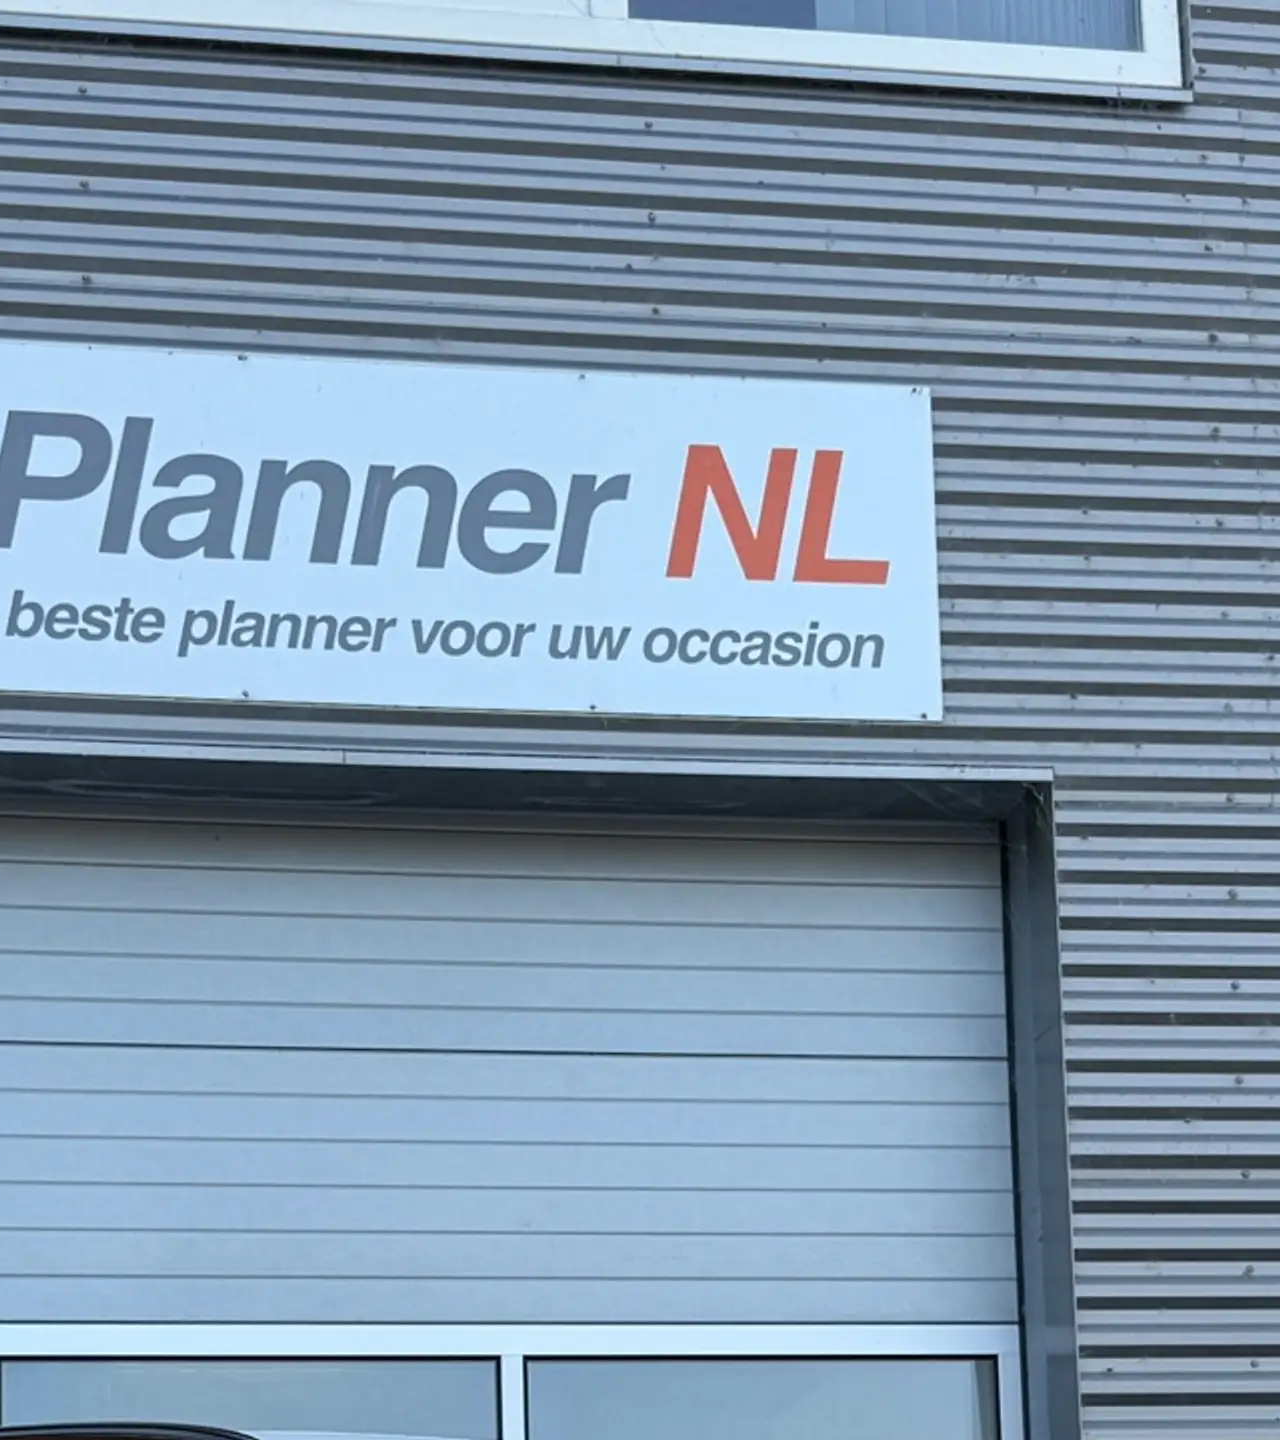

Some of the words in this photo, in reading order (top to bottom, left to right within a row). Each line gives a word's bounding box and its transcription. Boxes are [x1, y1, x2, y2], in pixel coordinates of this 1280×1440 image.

[665, 443, 890, 585] NL
[6, 589, 166, 644] beste
[177, 599, 398, 658] planner
[411, 619, 537, 658] voor
[548, 624, 632, 662] uw
[643, 621, 886, 669] occasion
